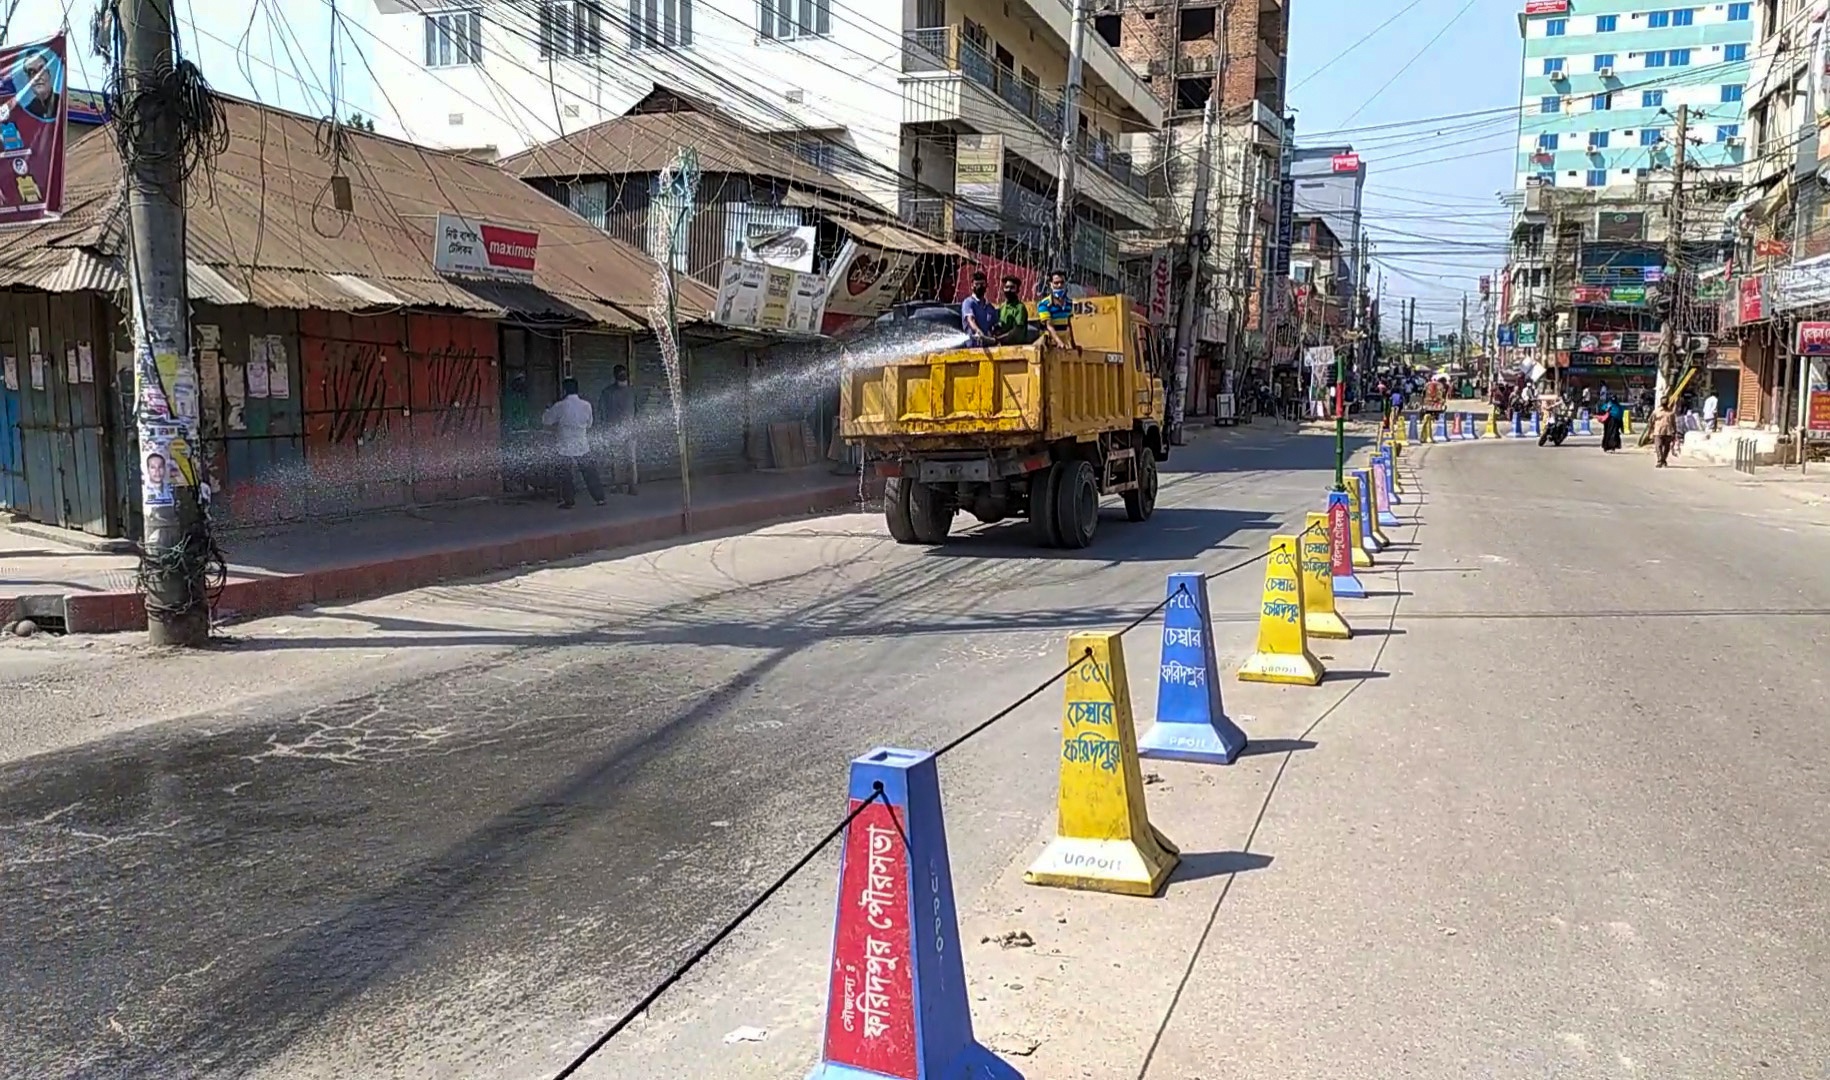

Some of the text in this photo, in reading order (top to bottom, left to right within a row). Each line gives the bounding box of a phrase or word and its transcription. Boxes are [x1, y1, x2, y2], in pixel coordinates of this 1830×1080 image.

[489, 240, 537, 260] maximus
[1164, 627, 1202, 648] চেম্বার
[1070, 663, 1110, 682] CCI
[1161, 660, 1206, 688] ফরিদপুর
[1066, 701, 1114, 728] চেম্বার
[1063, 732, 1121, 775] ফরিদপুর
[856, 823, 899, 1039] ফরিদপুর পৌরসভা
